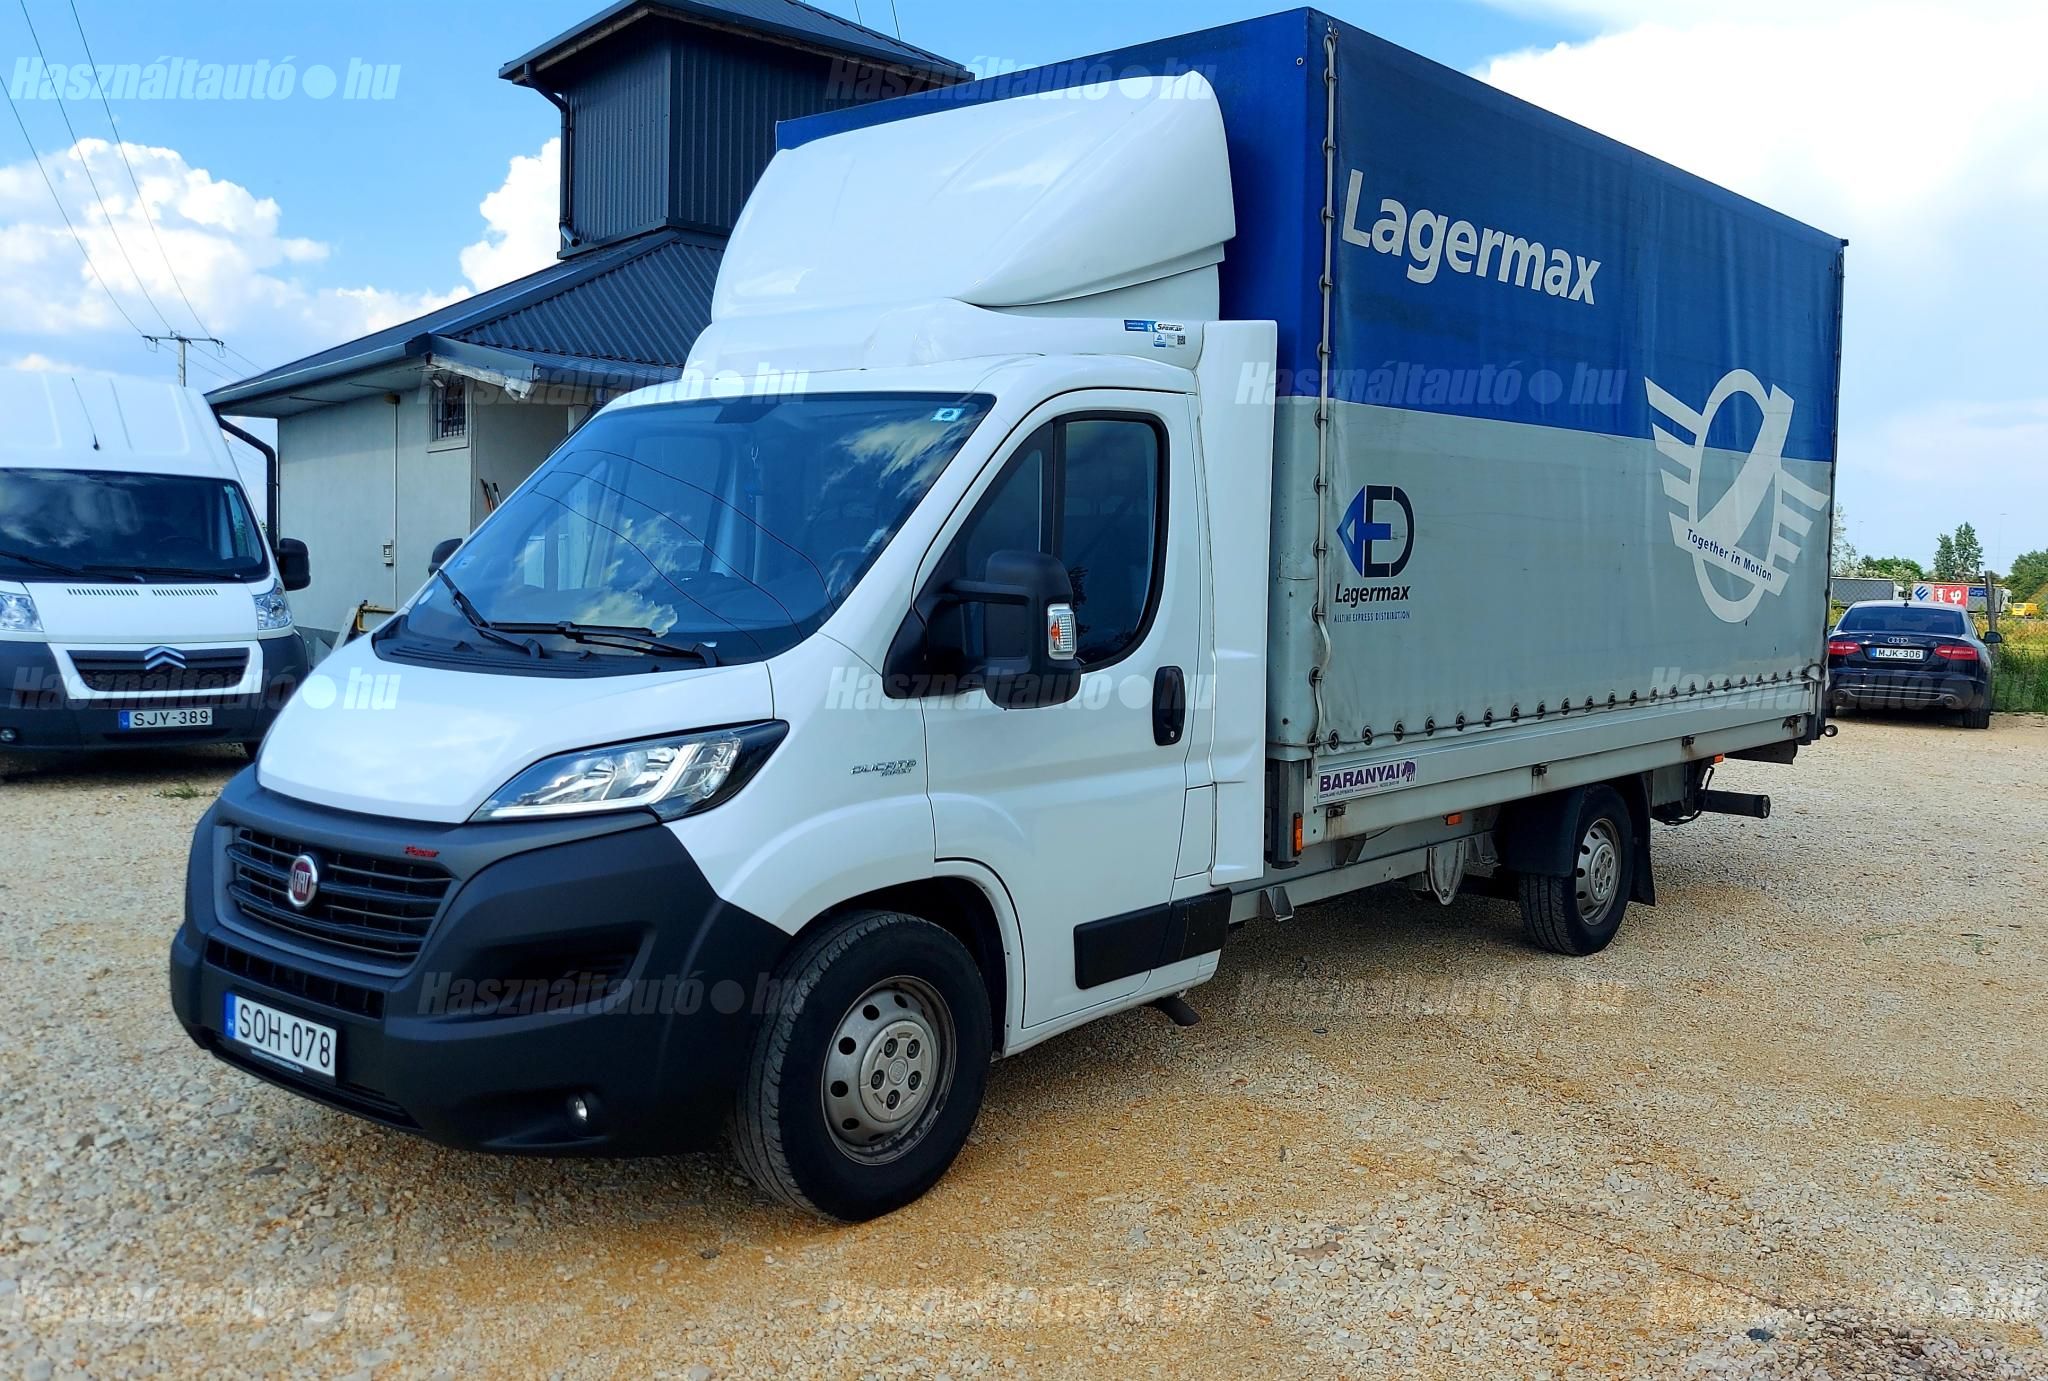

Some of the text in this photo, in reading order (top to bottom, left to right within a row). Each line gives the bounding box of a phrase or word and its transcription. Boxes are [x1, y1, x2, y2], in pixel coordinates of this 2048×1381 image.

[1342, 168, 1602, 305] Lagermax
[1687, 529, 1772, 581] Together in Motion
[1335, 583, 1411, 608] Lagermax
[1878, 649, 1921, 659] MJK-306
[134, 710, 208, 726] SJY-389
[1319, 763, 1400, 792] BARANYAI
[292, 869, 311, 895] FIAT
[239, 1004, 331, 1068] SOH-078
